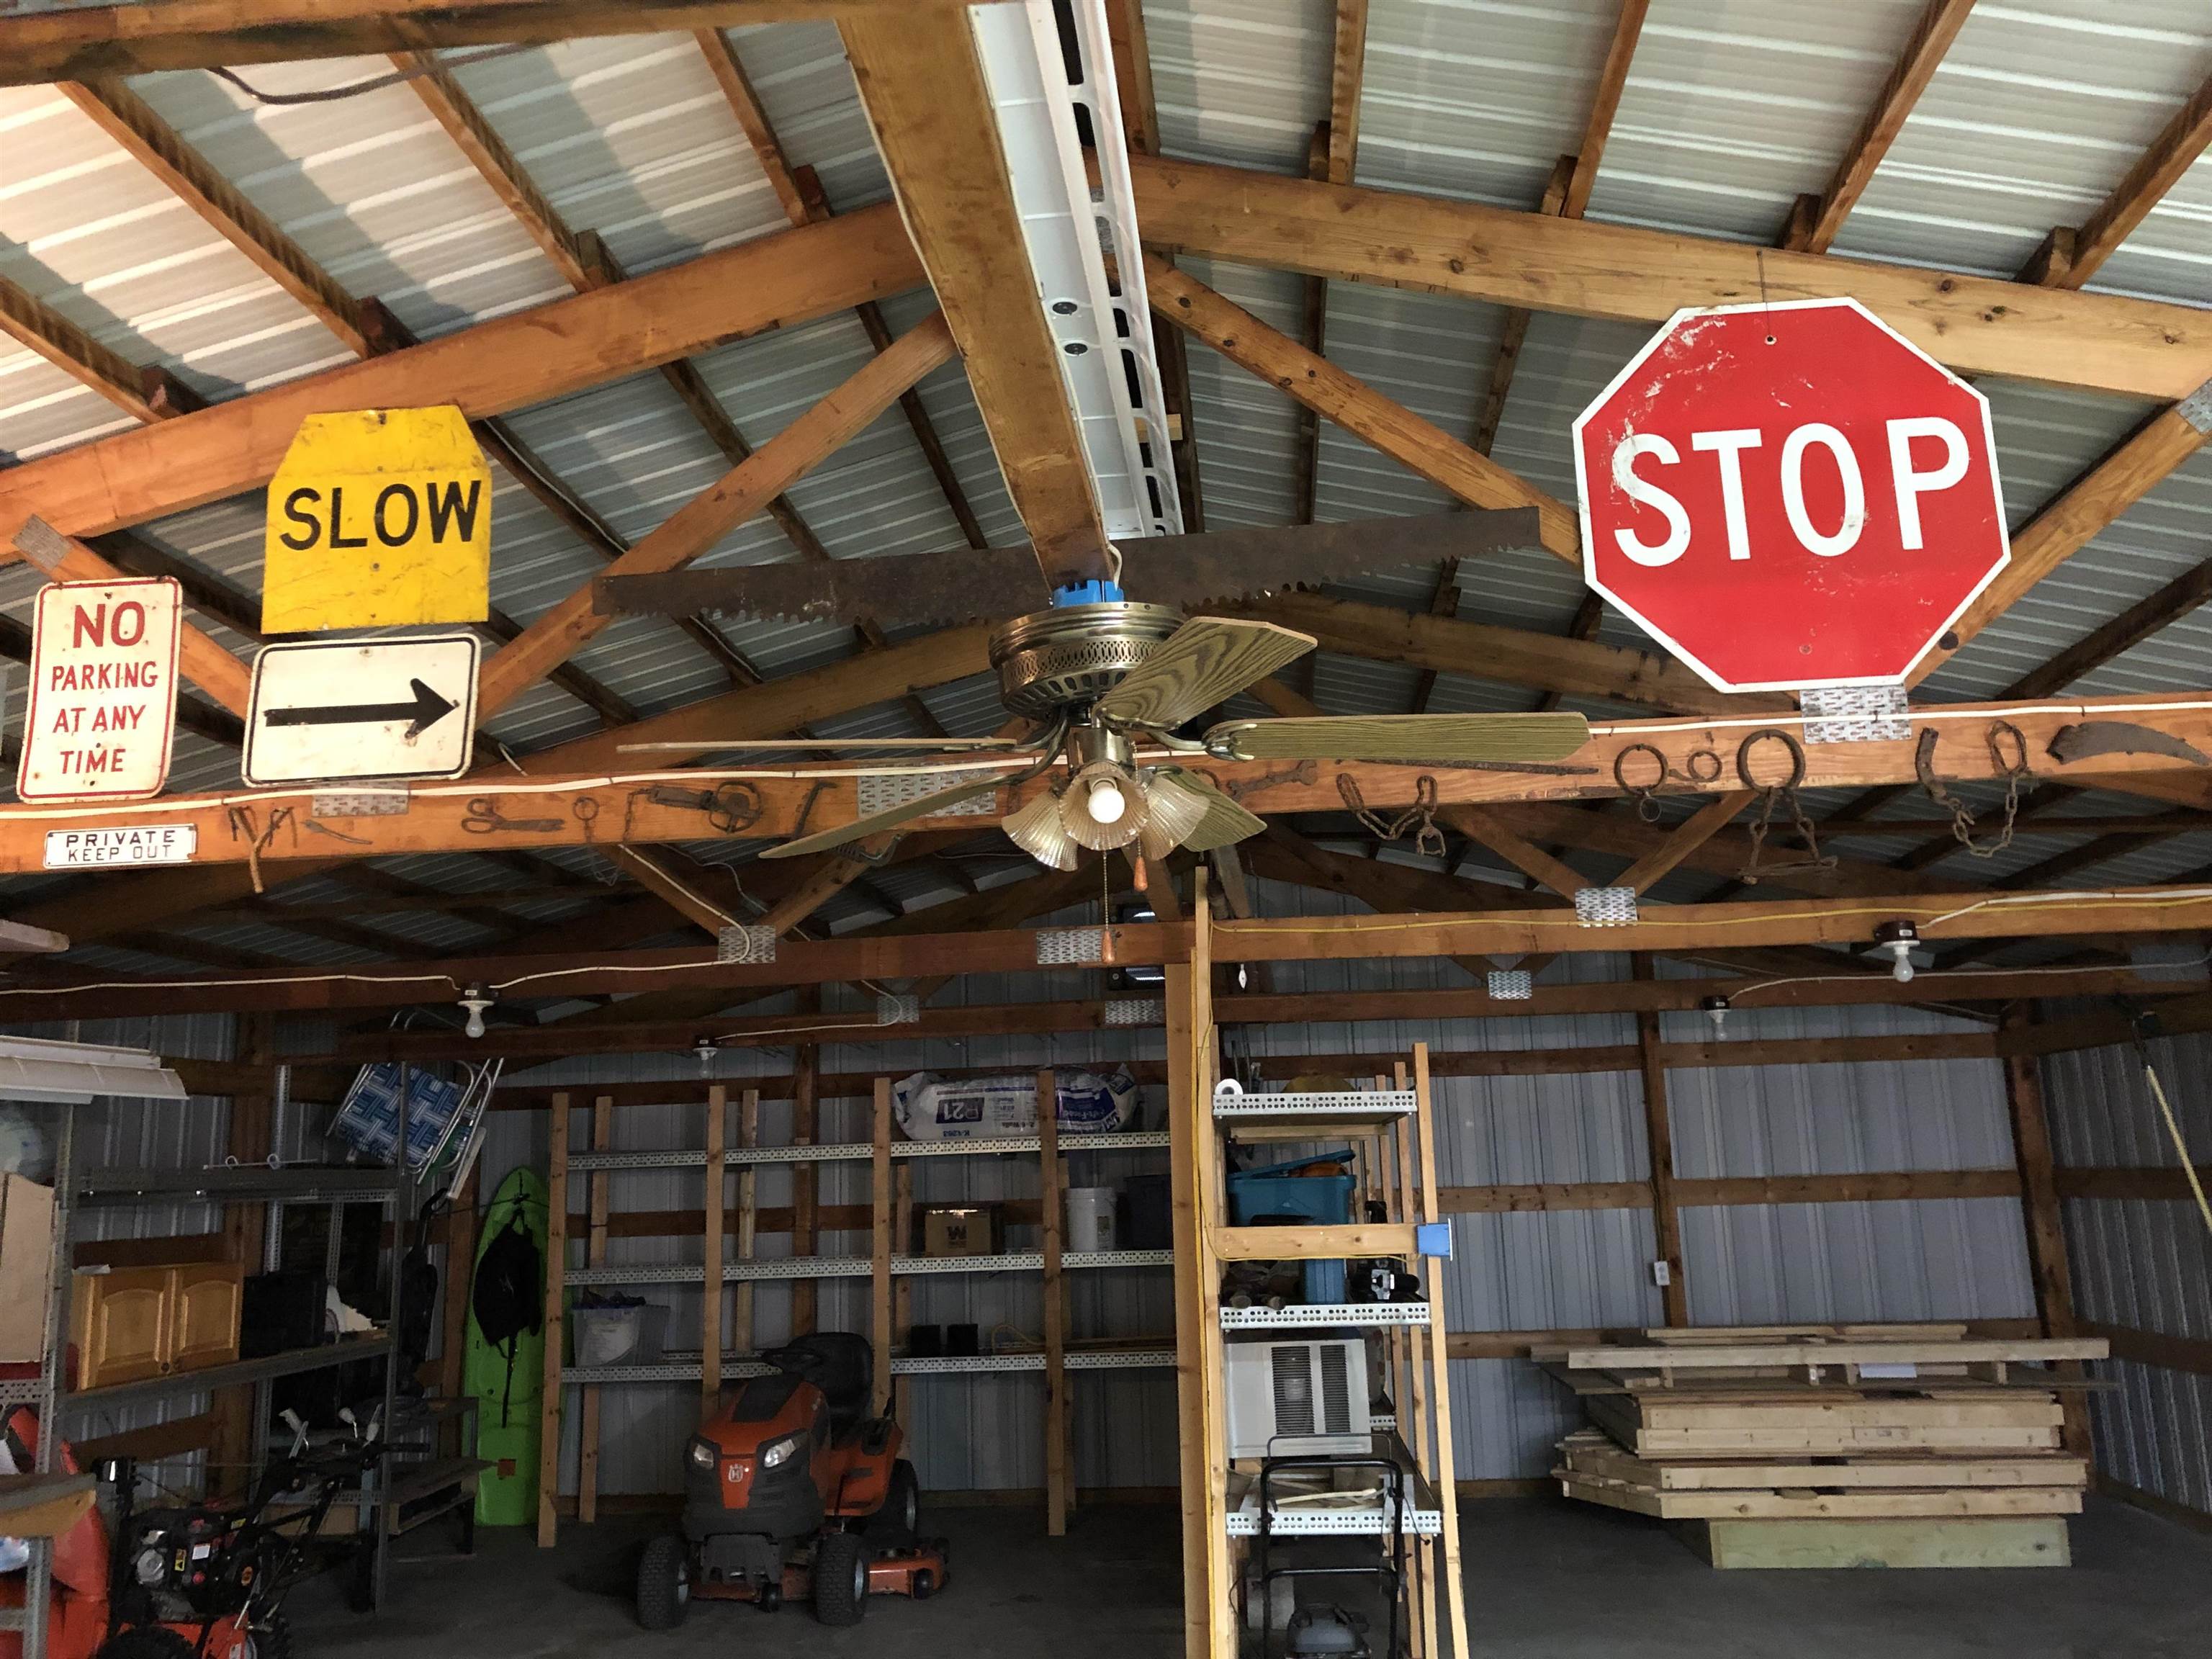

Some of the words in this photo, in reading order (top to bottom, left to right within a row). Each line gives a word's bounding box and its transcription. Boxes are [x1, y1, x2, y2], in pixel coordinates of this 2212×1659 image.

[1611, 416, 1970, 567] STOP
[279, 480, 482, 550] SLOW
[73, 601, 145, 649] NO
[52, 661, 158, 691] PARKING
[53, 706, 86, 733] AT
[92, 704, 146, 731] ANY
[60, 748, 127, 774] TIME
[66, 830, 176, 848] PRIVATE
[68, 847, 120, 862] KEEP
[133, 845, 171, 860] OUT
